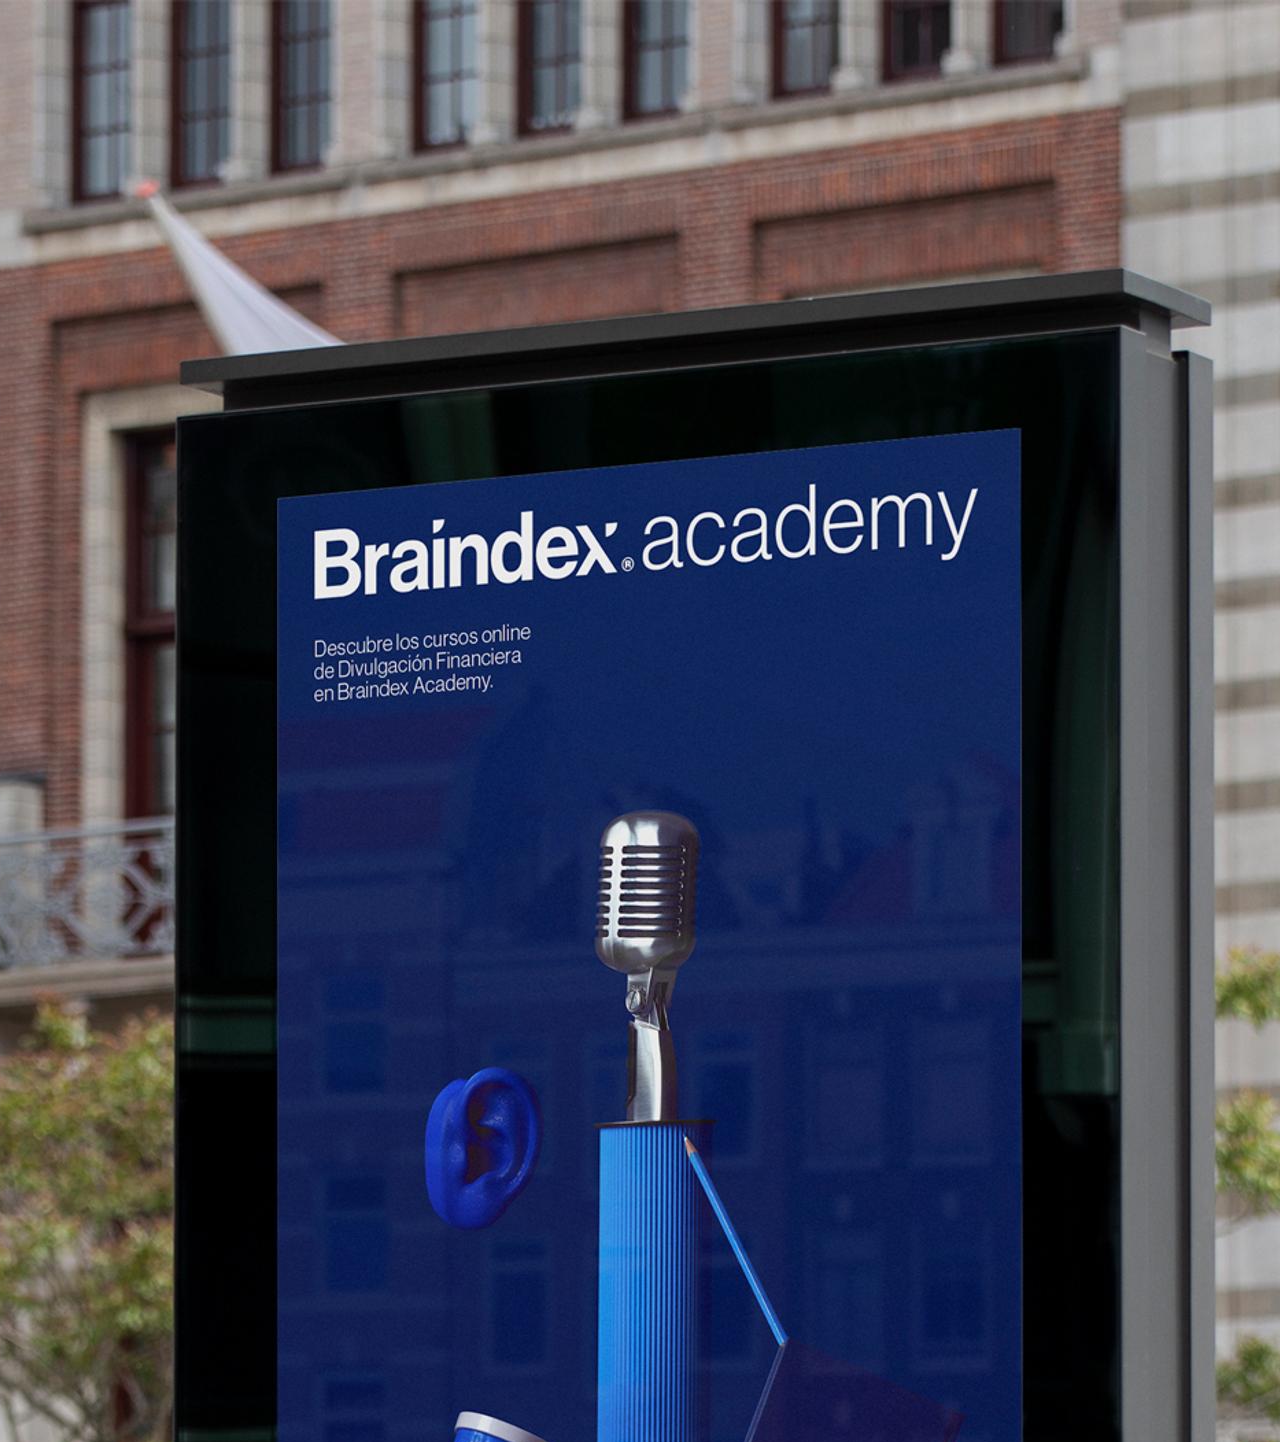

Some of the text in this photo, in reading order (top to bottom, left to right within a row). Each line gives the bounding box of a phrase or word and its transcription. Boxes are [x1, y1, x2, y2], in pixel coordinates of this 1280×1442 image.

[642, 483, 980, 571] academy
[313, 624, 532, 658] Descubre los cursos online
[313, 648, 522, 680] de Divulgación Financiera
[313, 673, 494, 702] en Braindex Academy.
